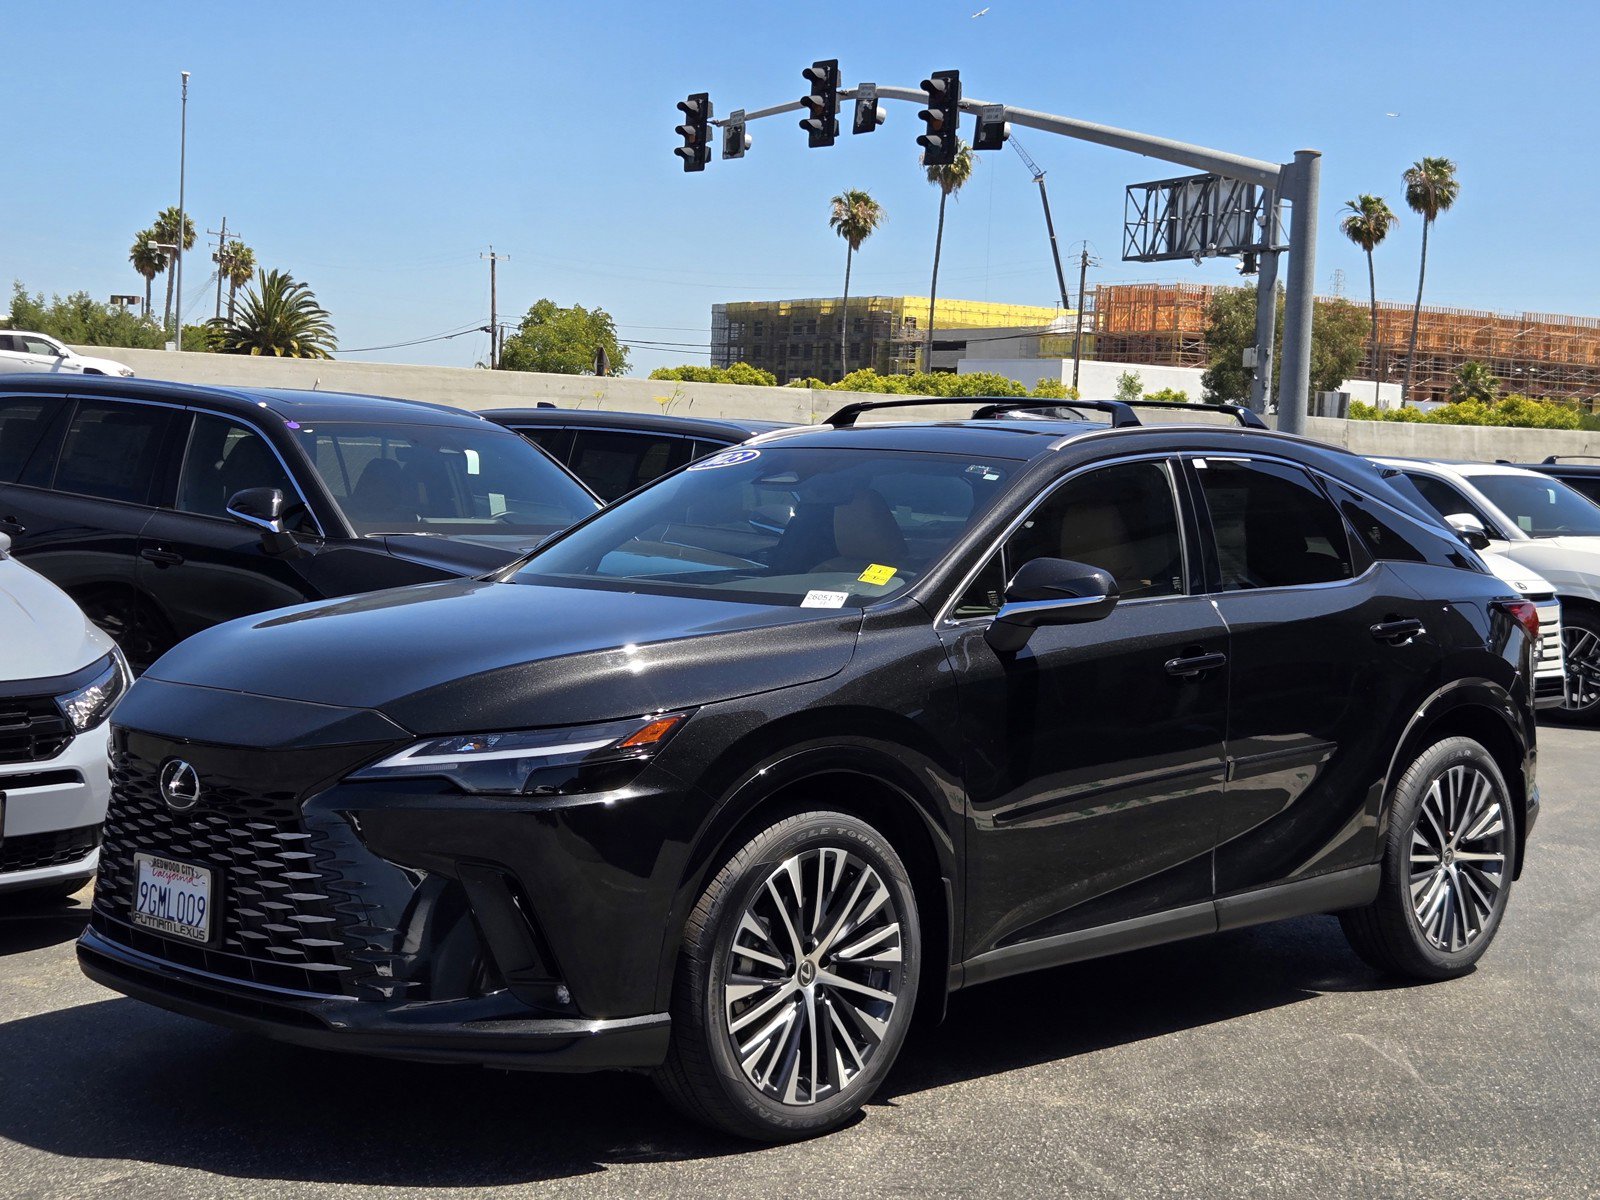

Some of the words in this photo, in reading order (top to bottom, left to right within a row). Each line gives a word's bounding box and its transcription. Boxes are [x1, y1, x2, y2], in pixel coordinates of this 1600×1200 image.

[151, 858, 180, 873] REDWOOD
[181, 864, 195, 877] CITY
[138, 881, 206, 928] 9GML009
[135, 913, 172, 931] PUTNAM
[174, 922, 205, 940] LEXUS
